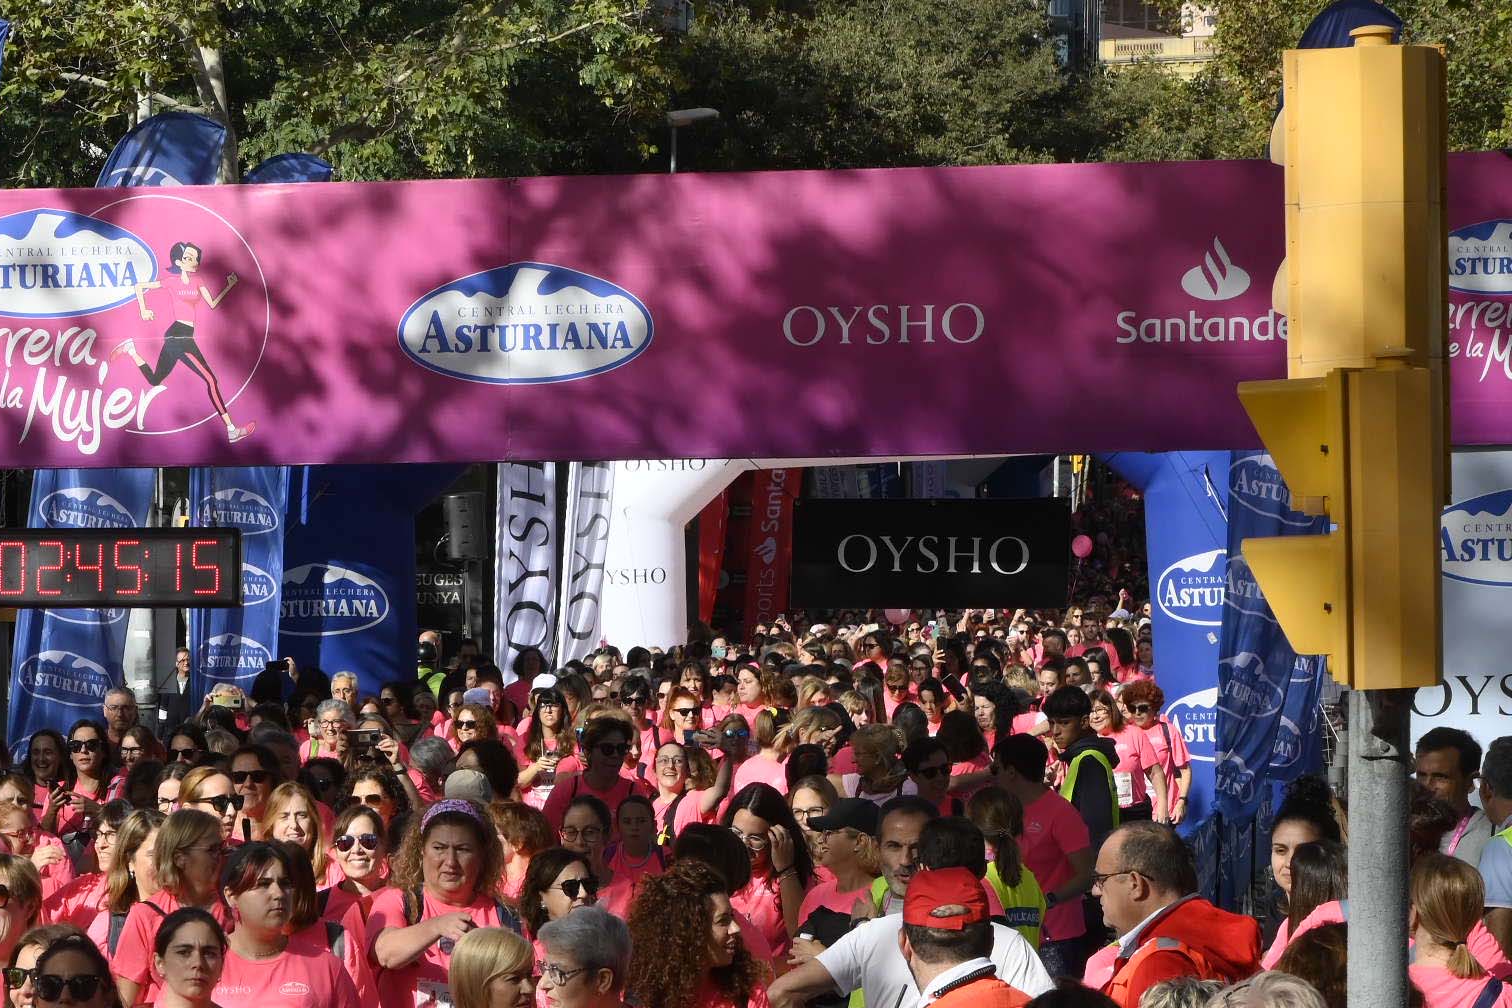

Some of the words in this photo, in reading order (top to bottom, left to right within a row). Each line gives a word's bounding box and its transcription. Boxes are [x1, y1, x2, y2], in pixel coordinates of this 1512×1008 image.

[58, 246, 133, 257] LECHERA
[457, 306, 535, 318] CENTRAL
[544, 304, 624, 316] LECHERA
[418, 310, 634, 354] ASTURIANA
[783, 303, 985, 346] OYSHO
[1115, 309, 1287, 345] Santande
[1466, 330, 1484, 358] la
[0, 367, 24, 409] la
[18, 360, 167, 455] Mujer
[625, 459, 707, 472] OYSHO
[200, 503, 273, 527] ASTURIANA
[506, 463, 550, 653] OYSH
[567, 464, 611, 641] OYSH
[838, 533, 1031, 575] OYSHO
[605, 567, 667, 585] YSHO
[1181, 576, 1223, 585] CENTRA
[326, 588, 375, 597] LECHERA
[280, 598, 380, 617] STURIANA
